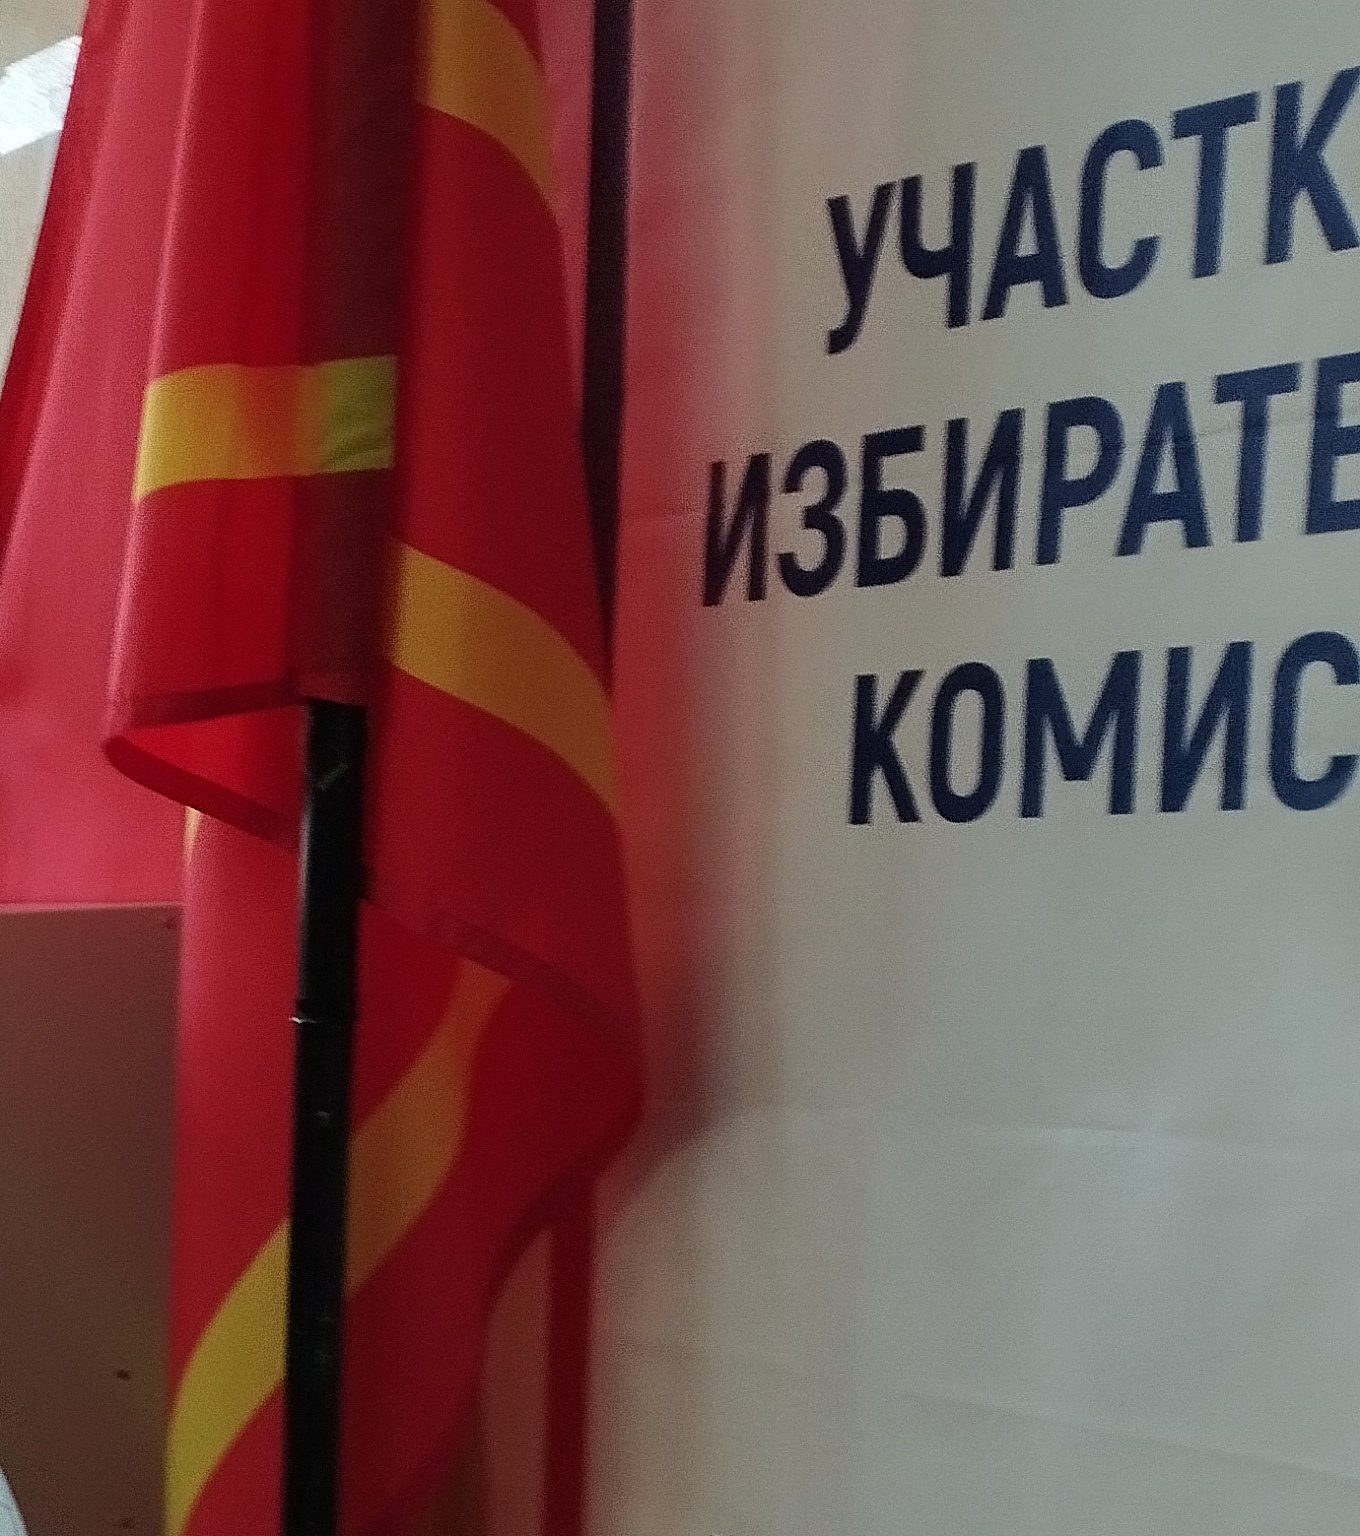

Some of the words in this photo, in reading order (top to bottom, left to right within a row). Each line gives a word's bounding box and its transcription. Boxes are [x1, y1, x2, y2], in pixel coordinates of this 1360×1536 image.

[825, 66, 1360, 355] УЧАСТК
[701, 352, 1360, 607] ИЗБИРАТЕ
[847, 631, 1360, 825] КОМИС
